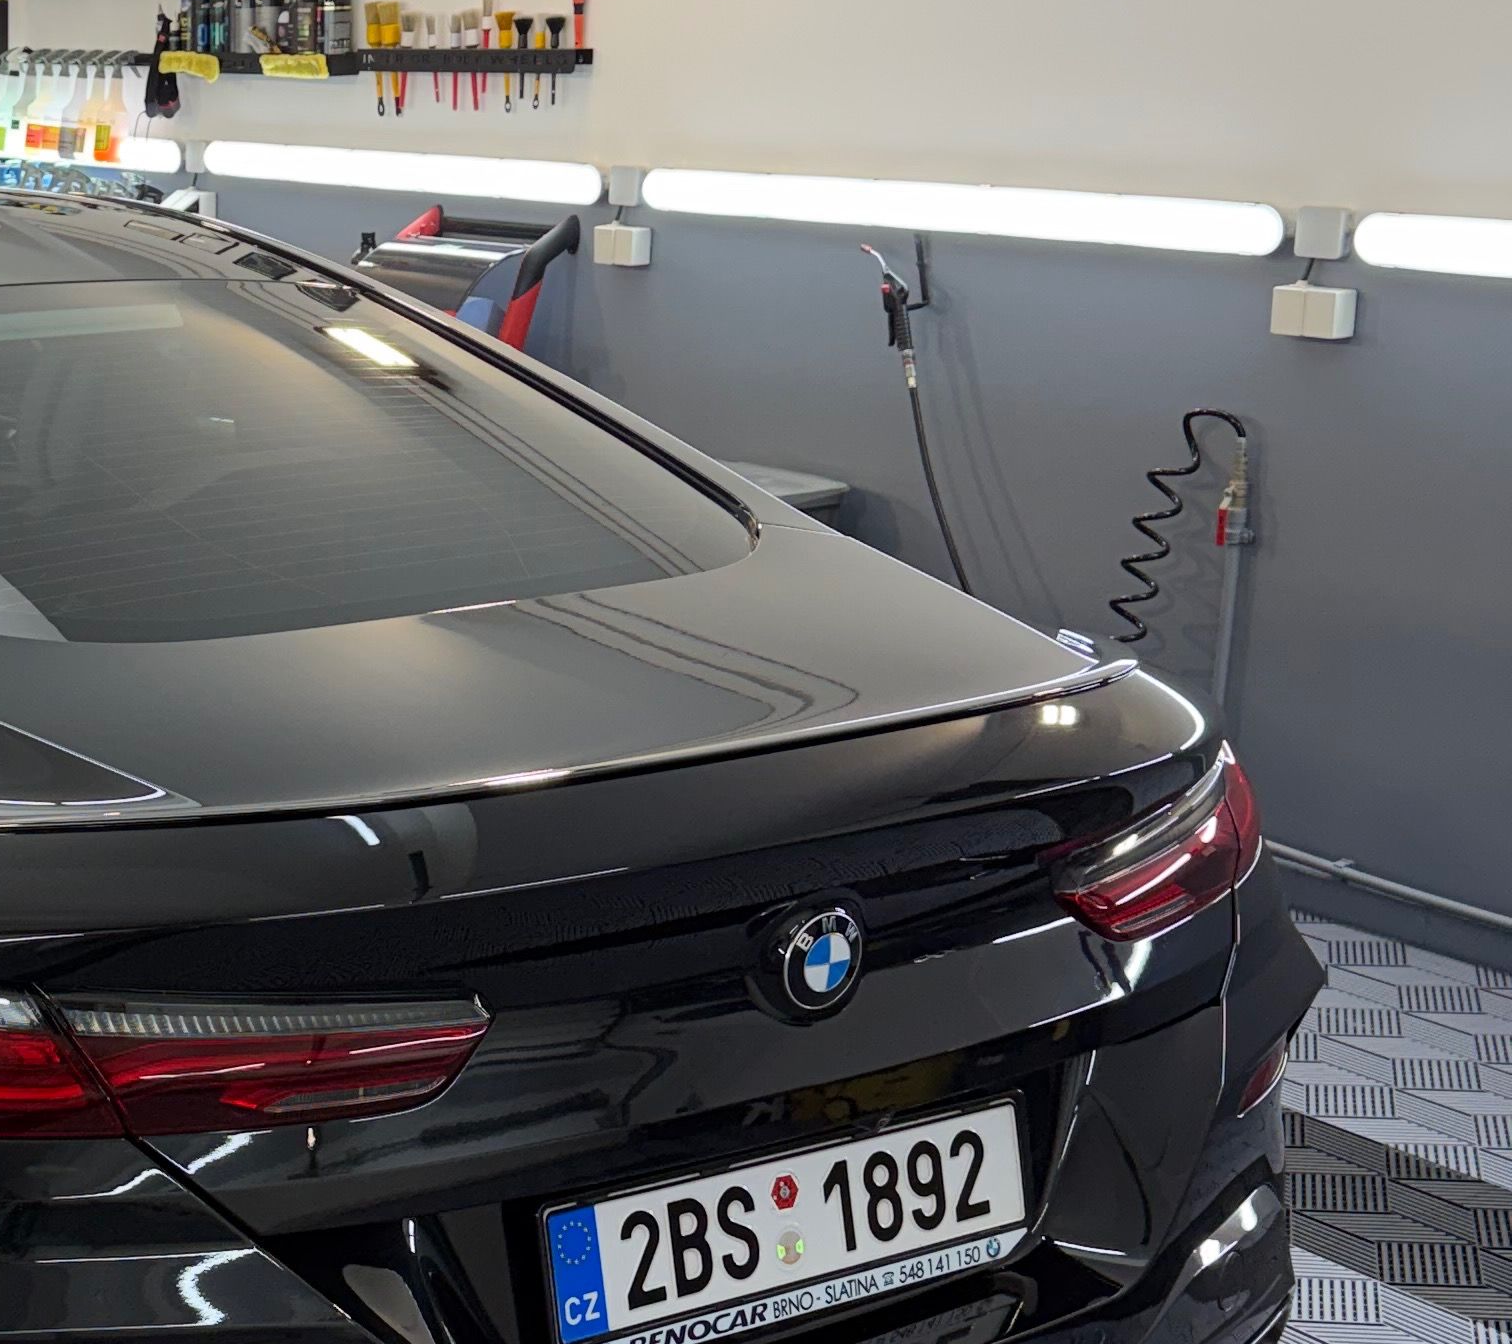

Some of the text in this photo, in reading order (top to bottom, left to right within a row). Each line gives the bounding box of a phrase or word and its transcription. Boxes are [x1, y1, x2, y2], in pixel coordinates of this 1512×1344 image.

[795, 916, 859, 953] BMW
[619, 1129, 992, 1311] 2BS 1892
[564, 1290, 601, 1327] CZ
[772, 1291, 814, 1320] BRNO
[824, 1273, 879, 1310] SLATINA
[898, 1260, 926, 1285] 548
[928, 1253, 951, 1277] 141
[956, 1246, 981, 1271] 150
